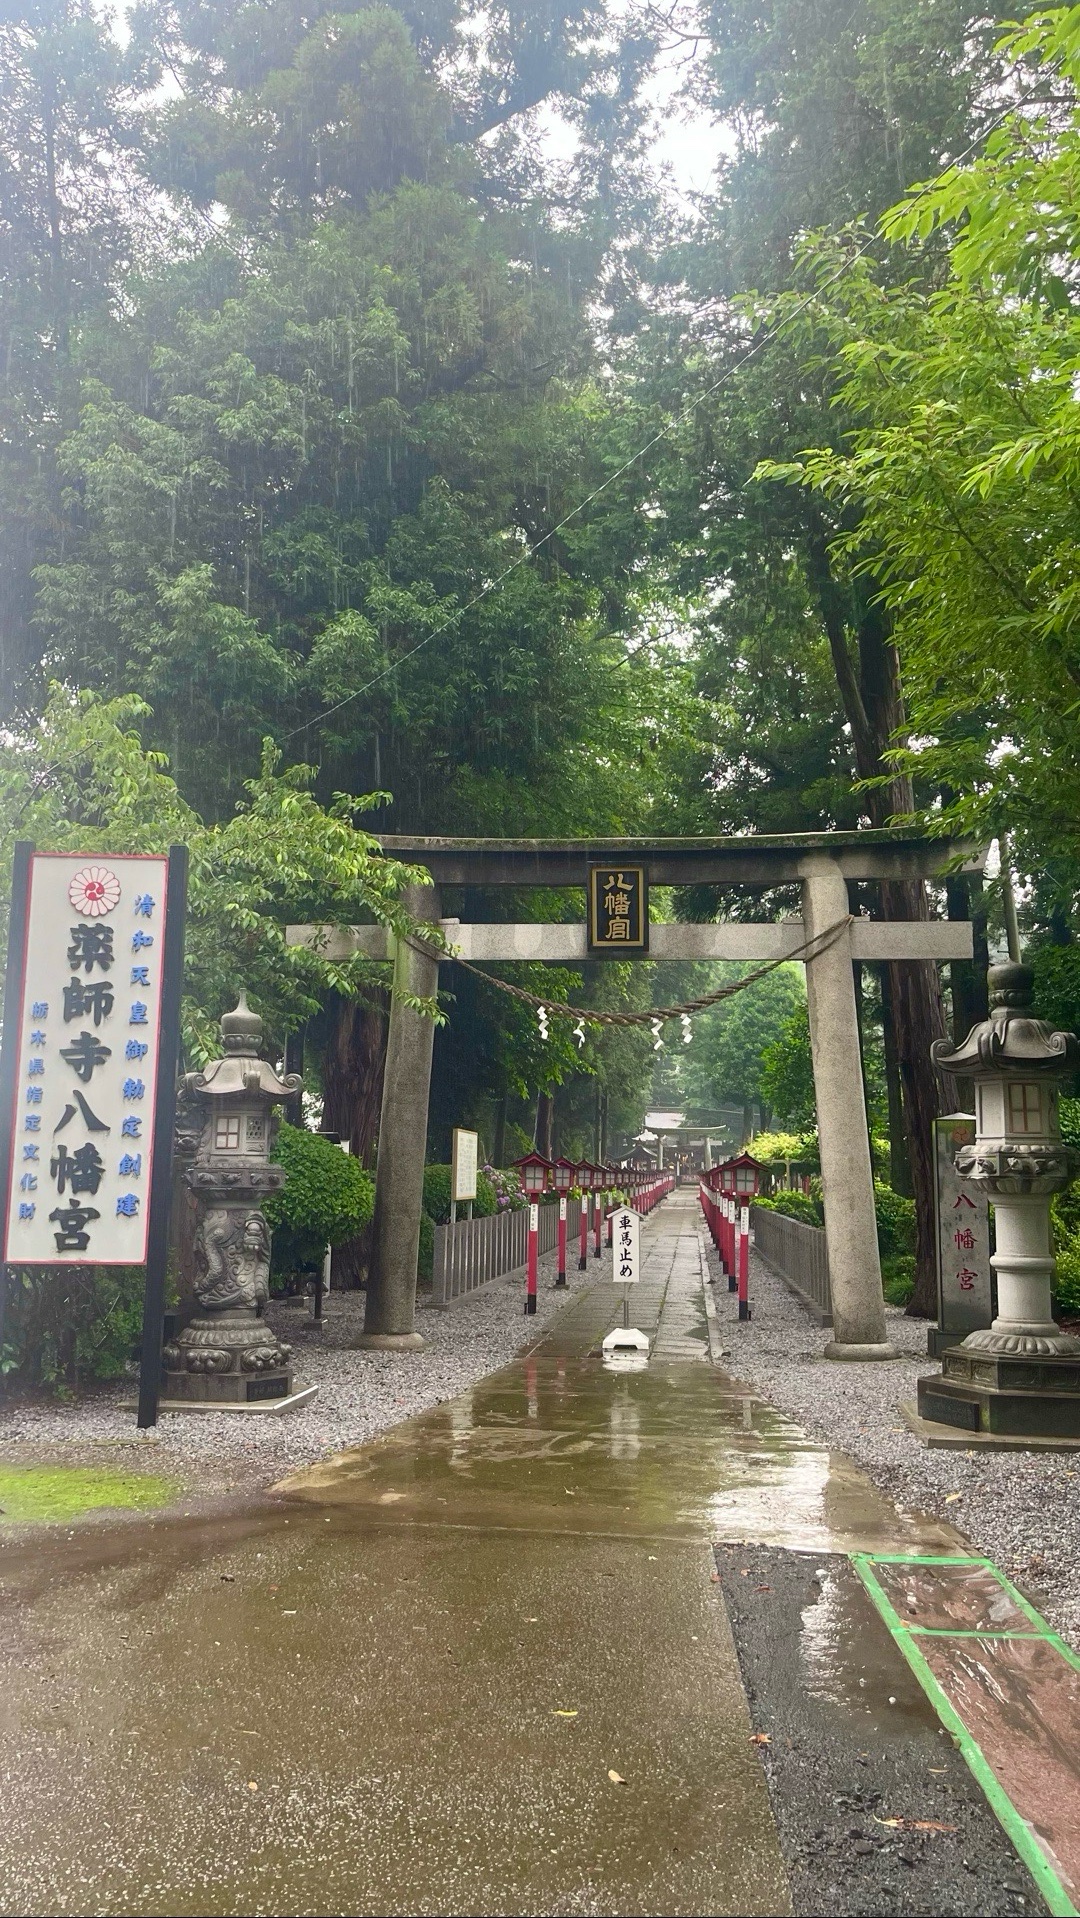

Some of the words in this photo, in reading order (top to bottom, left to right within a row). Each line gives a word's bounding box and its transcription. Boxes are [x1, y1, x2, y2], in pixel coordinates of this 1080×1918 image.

[603, 873, 634, 939] 八幡宮
[19, 1001, 49, 1219] 栃木県指定文化財
[48, 922, 115, 1252] 薬師寺八幡宮
[115, 894, 156, 1218] 清和天皇御勅定創建
[619, 1215, 633, 1277] 車馬止め
[953, 1192, 978, 1291] 八幡宮
